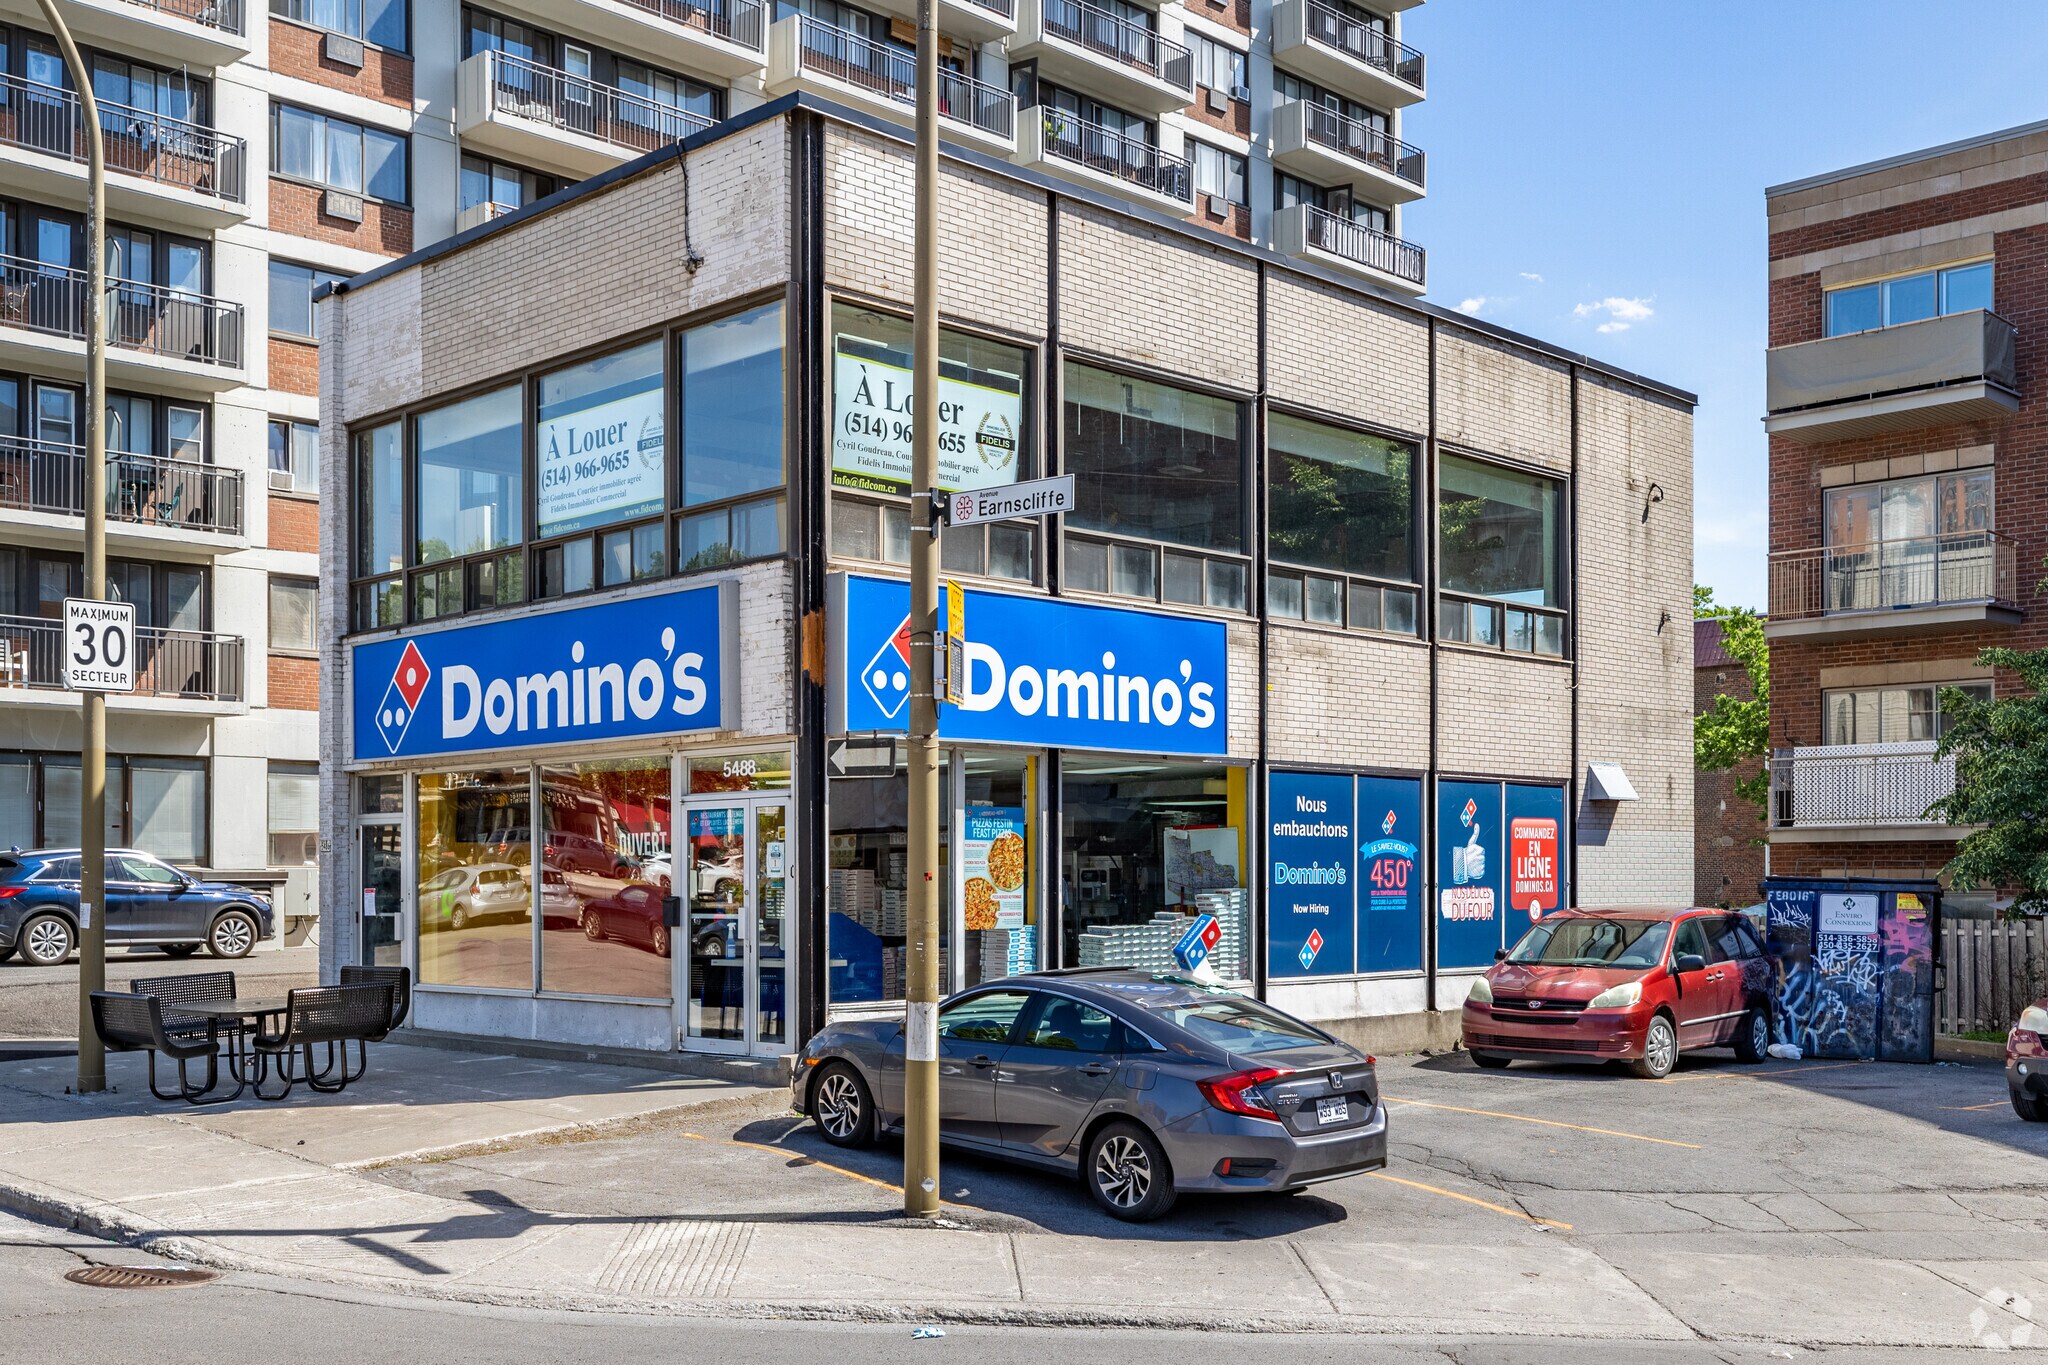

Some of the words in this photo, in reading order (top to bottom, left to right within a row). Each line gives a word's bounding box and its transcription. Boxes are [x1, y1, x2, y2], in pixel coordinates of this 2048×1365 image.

[852, 364, 875, 407] À
[884, 380, 964, 426] Loer
[845, 411, 888, 442] (514)
[893, 421, 966, 453] 96655
[546, 424, 561, 462] À
[568, 421, 628, 456] Louer
[981, 434, 1010, 449] FIDELIS
[836, 438, 856, 451] Cyril
[857, 442, 895, 457] Goudreau,
[896, 450, 912, 461] Cour
[962, 465, 979, 474] agréé
[857, 456, 881, 468] Fidelis
[541, 465, 571, 492] (514)
[574, 449, 630, 481] 966-9655
[577, 484, 599, 496] Courtier
[599, 479, 627, 493] immobilier
[833, 474, 897, 494] info@fidcom.ca
[551, 503, 567, 514] Fidelis
[568, 497, 596, 512] Immobilier
[596, 489, 627, 503] Commercial
[978, 490, 1065, 517] Earnscliffe
[979, 490, 999, 499] Avenue
[70, 606, 129, 622] MAXIMUM
[73, 622, 126, 668] 30
[72, 669, 128, 684] SECTEUR
[441, 626, 707, 739] Domino's
[957, 641, 1216, 729] Domino's
[723, 759, 757, 778] 5488
[1296, 795, 1327, 813] Nous
[971, 817, 993, 828] PIZZAS
[993, 818, 1013, 829] FESTIN
[1273, 820, 1348, 838] embauchons
[972, 828, 991, 838] FEAST
[991, 828, 1012, 839] PIZZAS
[1514, 826, 1555, 840] COMMANDEZ
[619, 831, 667, 857] OUVERT
[1371, 844, 1377, 853] LE
[1377, 842, 1409, 853] SAVIEZ-VOUS?
[1528, 840, 1541, 857] EN
[1274, 861, 1347, 885] Domino's
[1517, 857, 1552, 879] LIGNE
[1515, 880, 1554, 893] DOMINOS.CA
[1293, 904, 1309, 914] Now
[1309, 903, 1330, 915] Hiring
[1451, 902, 1466, 921] DU
[1467, 902, 1493, 921] FOUR
[1825, 918, 1872, 927] CONNEXIONS
